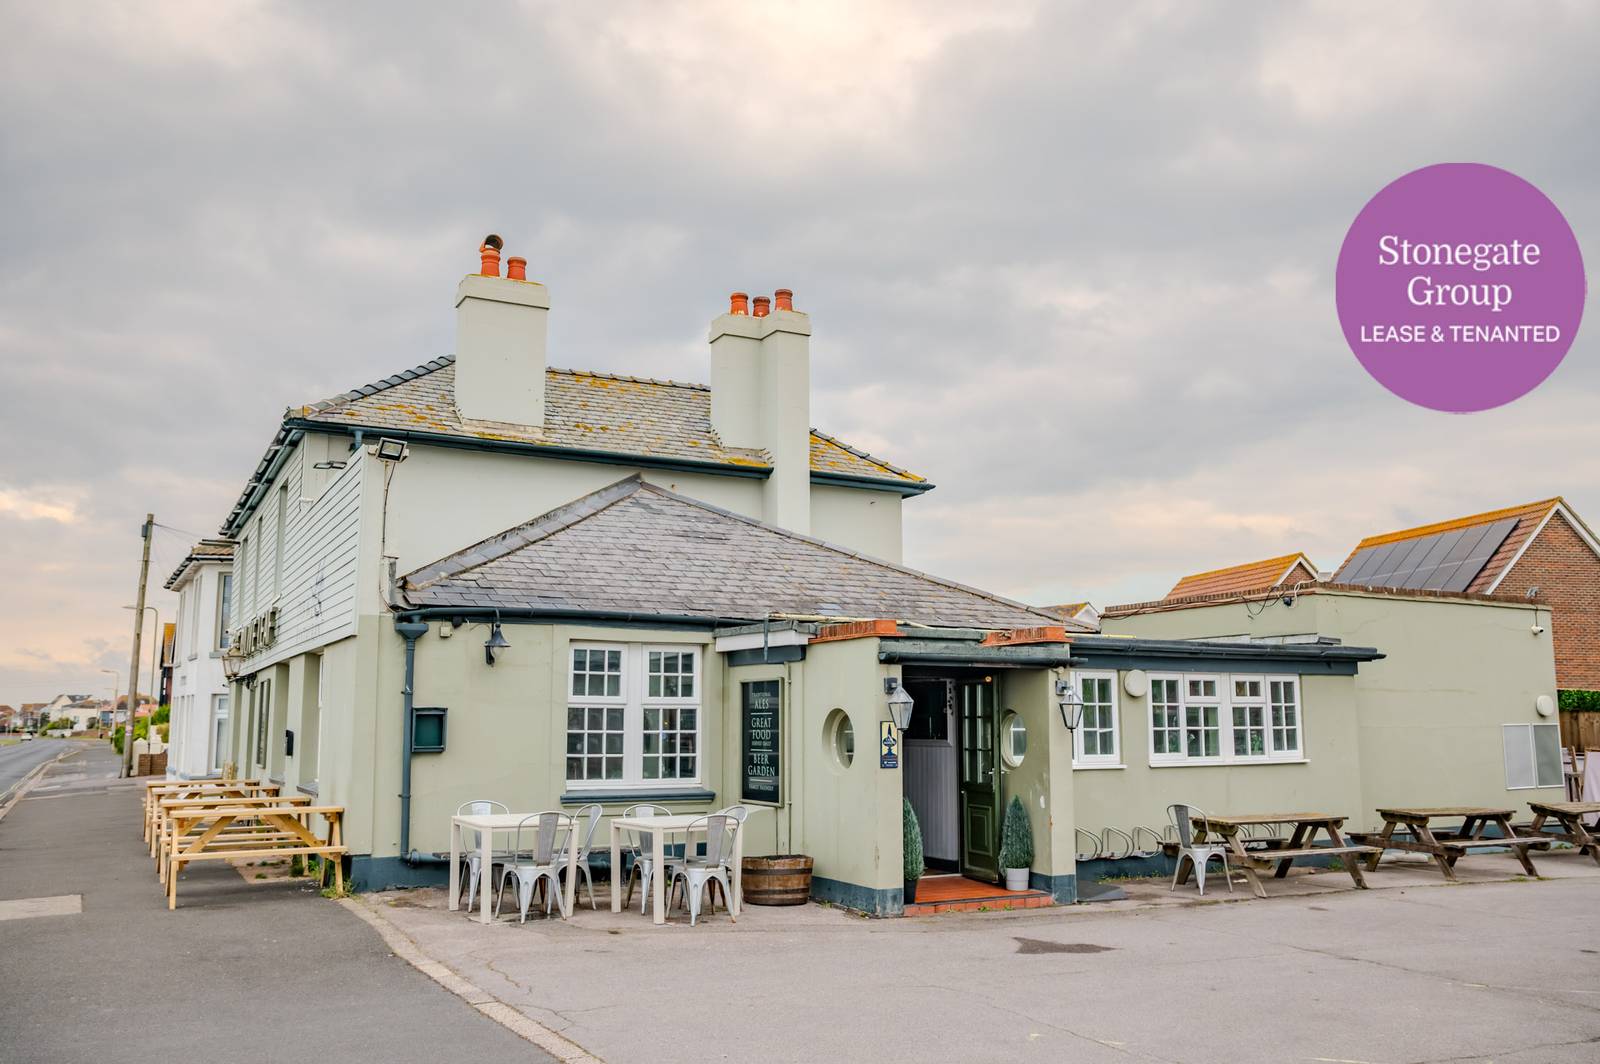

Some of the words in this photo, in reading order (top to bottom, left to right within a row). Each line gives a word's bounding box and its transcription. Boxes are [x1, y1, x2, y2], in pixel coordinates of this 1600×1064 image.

[754, 698, 769, 710] ALES
[751, 717, 772, 728] GREAT
[752, 729, 771, 740] FOOD
[753, 753, 769, 765] BEER
[747, 764, 775, 777] GARDEN
